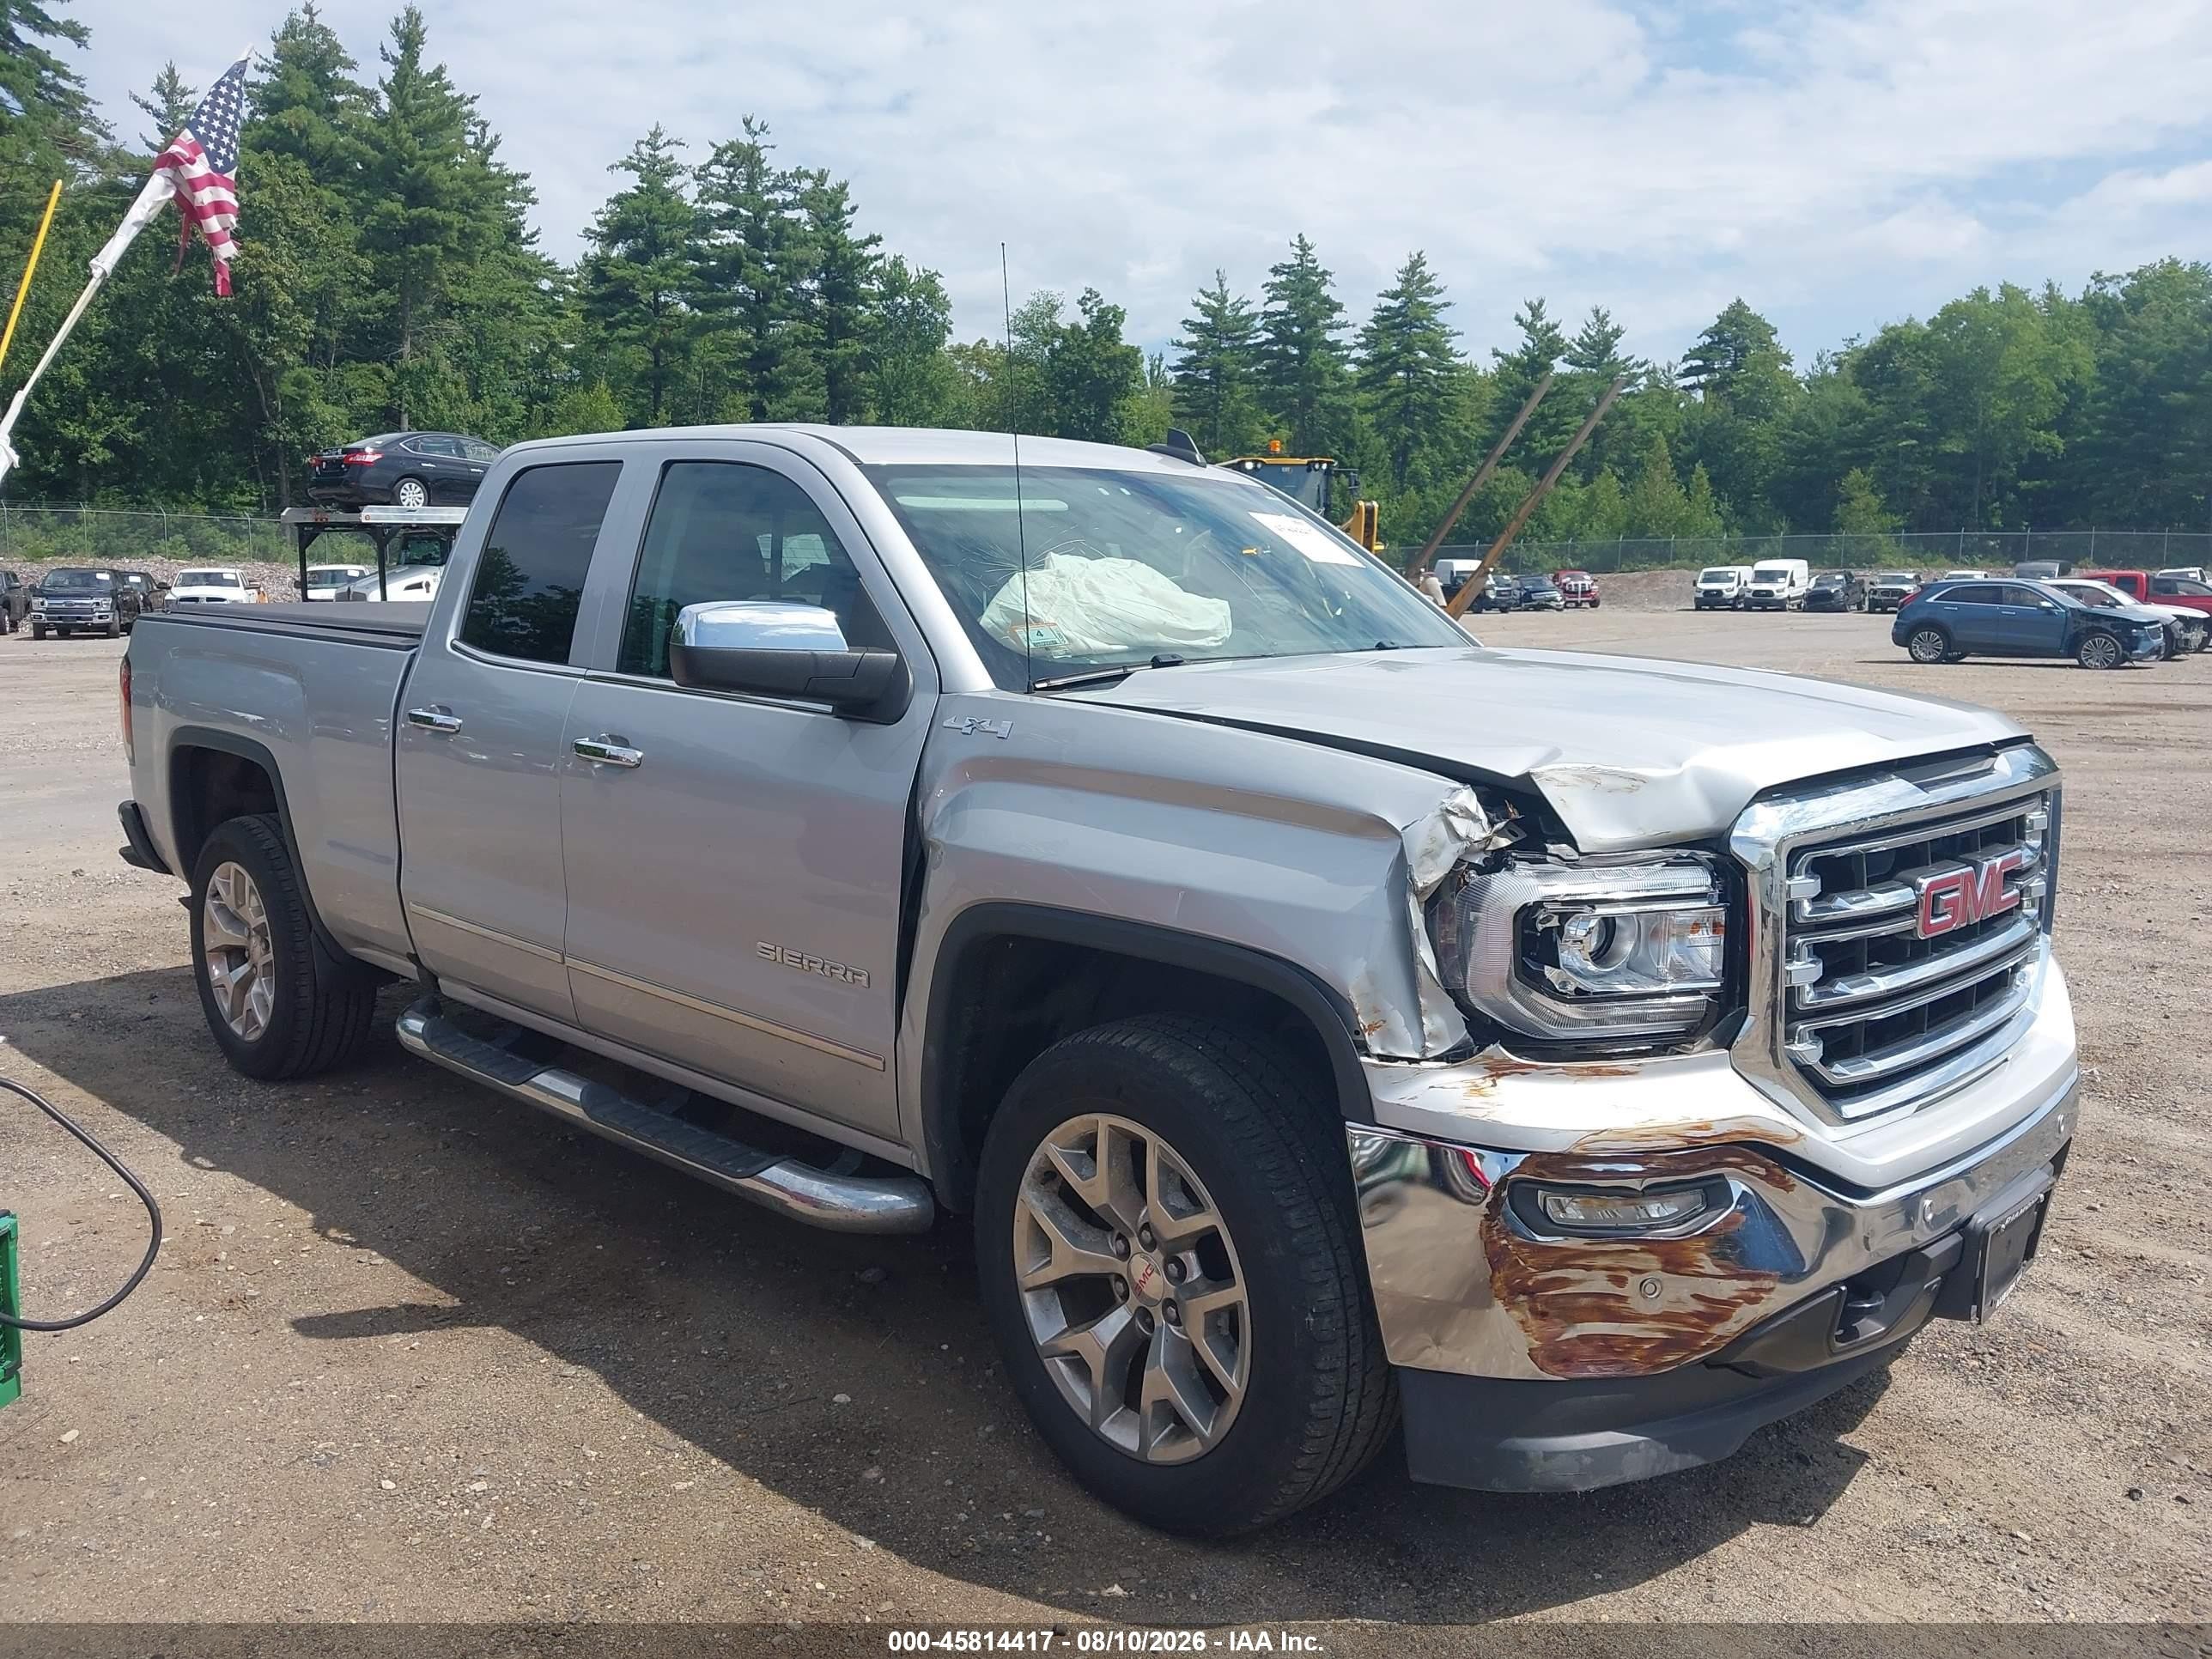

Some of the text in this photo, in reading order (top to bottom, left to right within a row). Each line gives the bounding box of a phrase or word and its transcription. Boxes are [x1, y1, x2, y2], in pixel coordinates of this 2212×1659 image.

[1036, 629, 1044, 638] 4
[1916, 850, 2022, 940] GMC
[756, 941, 871, 988] SIERRA
[1133, 1263, 1155, 1297] GMC
